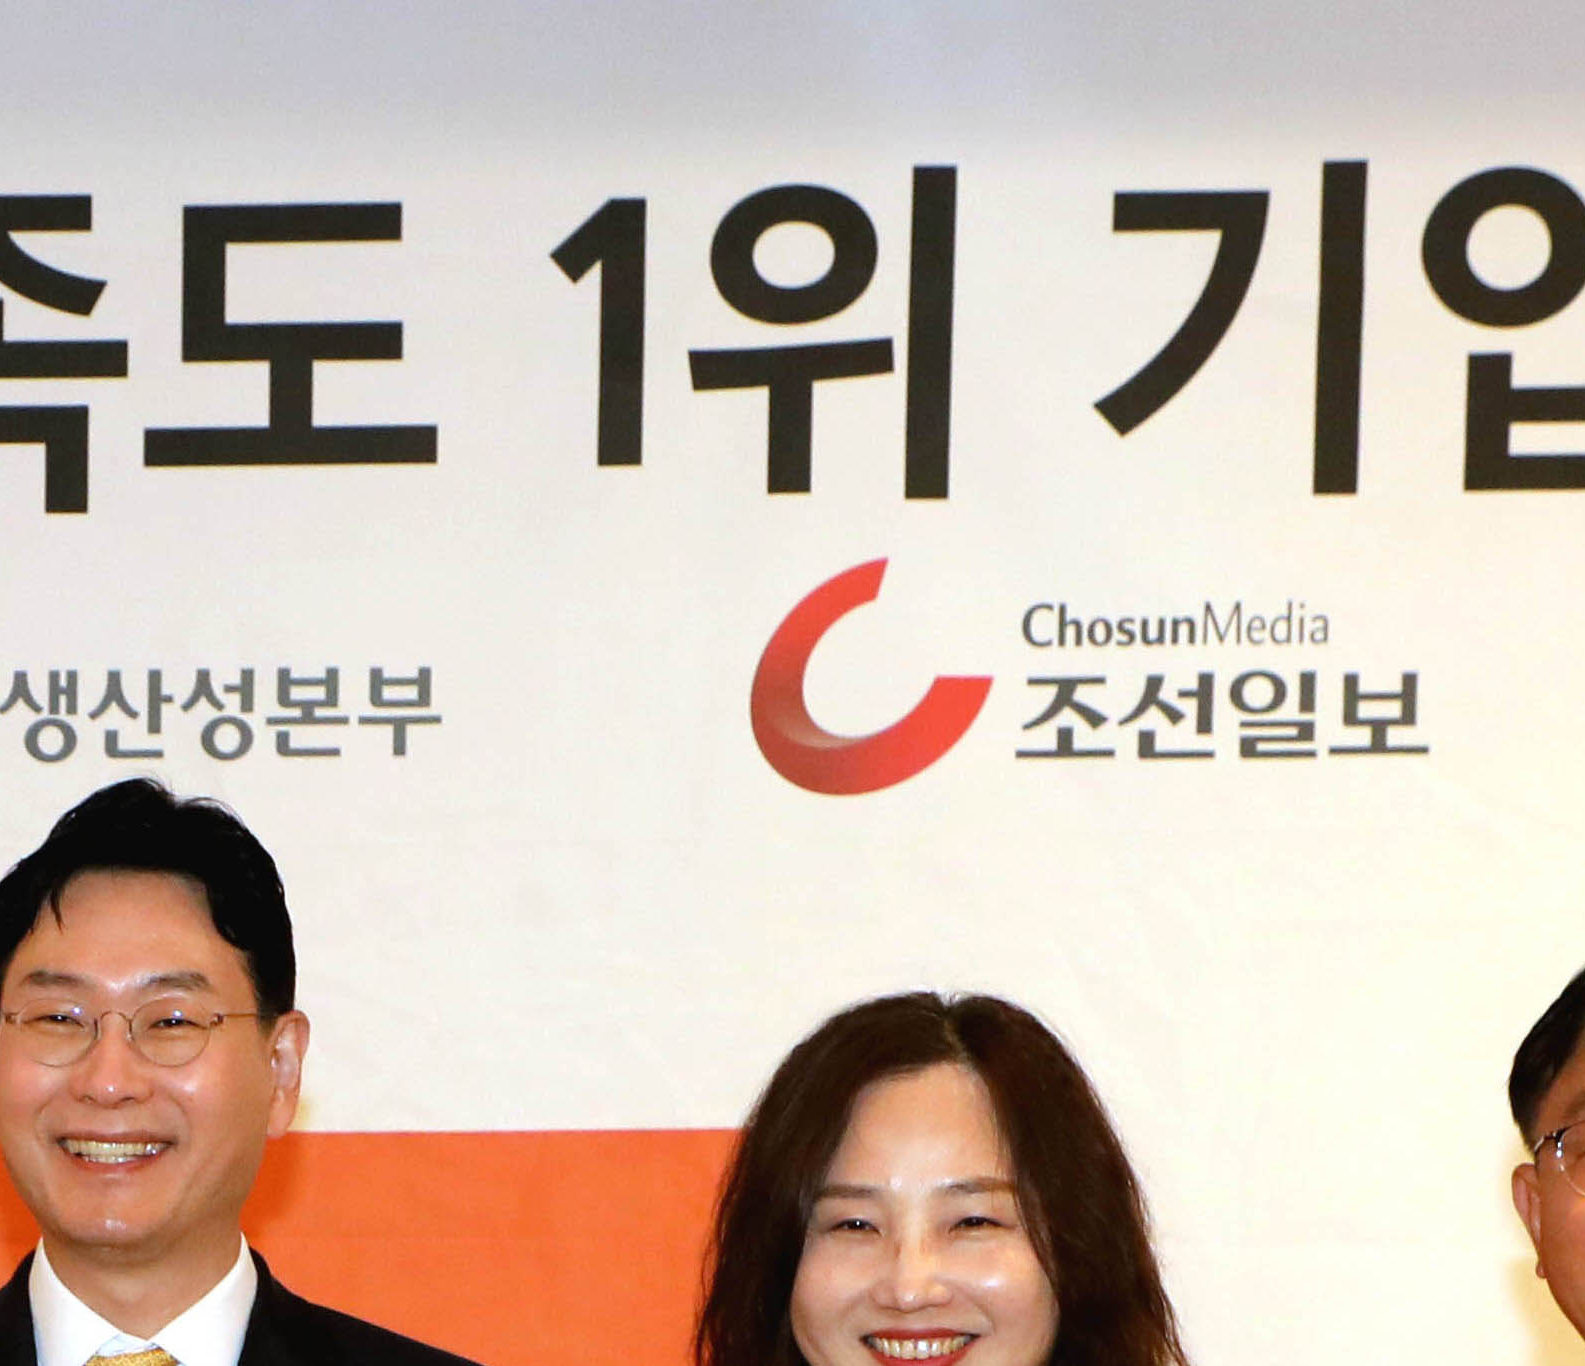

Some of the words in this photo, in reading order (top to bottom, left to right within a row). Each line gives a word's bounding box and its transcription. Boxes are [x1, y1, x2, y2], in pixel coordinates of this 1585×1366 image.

[549, 165, 960, 500] 1위
[1021, 601, 1332, 650] ChosunMedia
[1014, 670, 1431, 762] 조선일보
